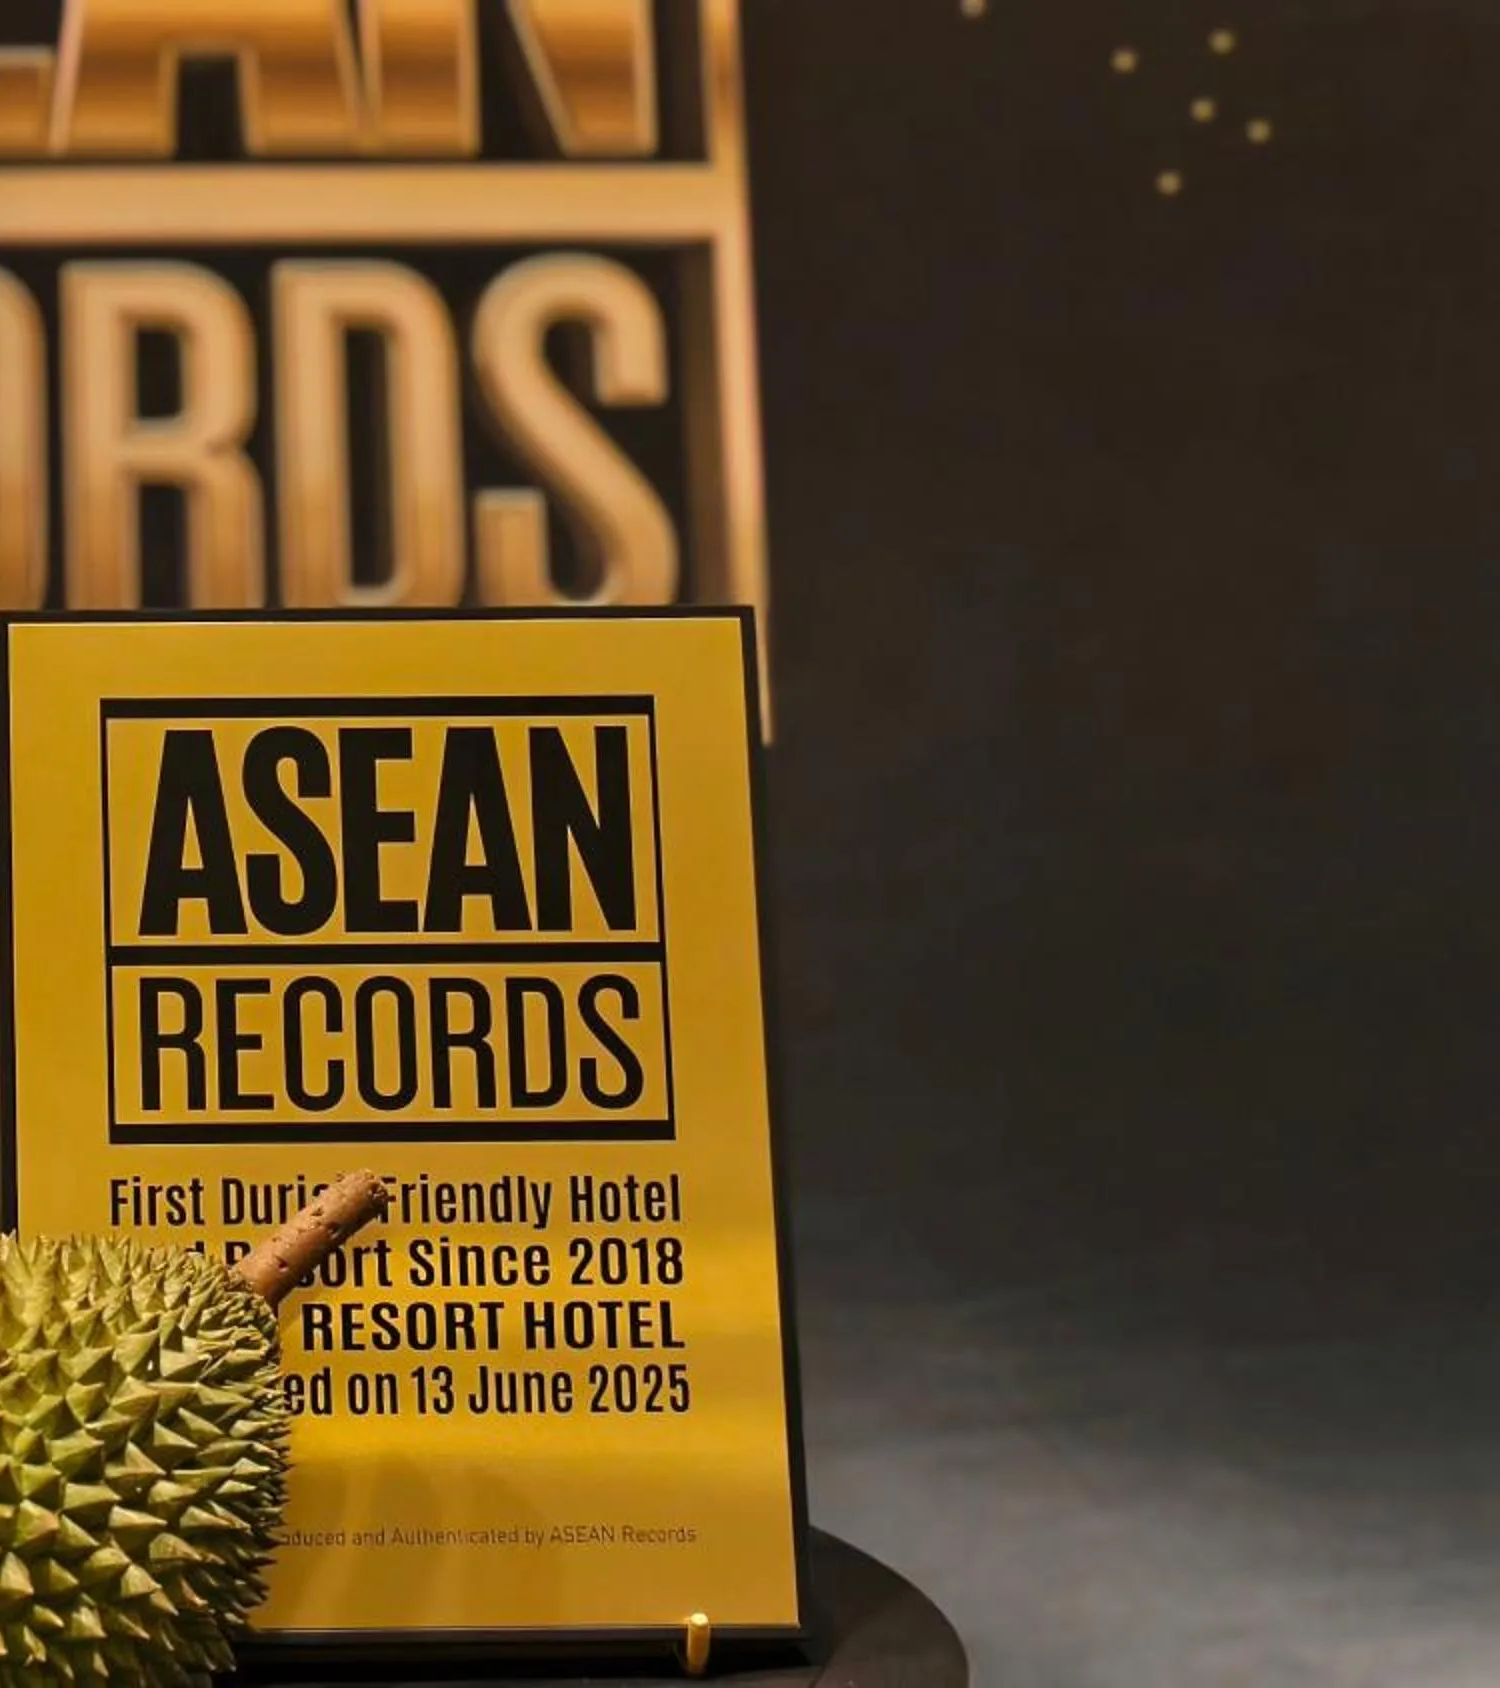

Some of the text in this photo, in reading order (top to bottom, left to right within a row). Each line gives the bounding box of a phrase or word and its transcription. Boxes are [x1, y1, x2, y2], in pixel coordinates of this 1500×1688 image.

[137, 725, 637, 937] ASEAN
[138, 973, 644, 1112] RECORDS
[109, 1175, 206, 1227] First
[221, 1174, 330, 1227] Duri
[569, 1173, 682, 1224] Hotel
[408, 1236, 550, 1287] Since
[568, 1237, 684, 1286] 2018
[300, 1300, 686, 1352] RESORT HOTEL
[347, 1372, 399, 1416] on
[410, 1364, 455, 1415] 13
[468, 1364, 574, 1415] June
[588, 1363, 691, 1414] 2025
[352, 1527, 386, 1546] and
[391, 1525, 519, 1546] Authenticated
[524, 1526, 545, 1549] by
[550, 1524, 616, 1543] ASEAN
[622, 1524, 698, 1543] Records
